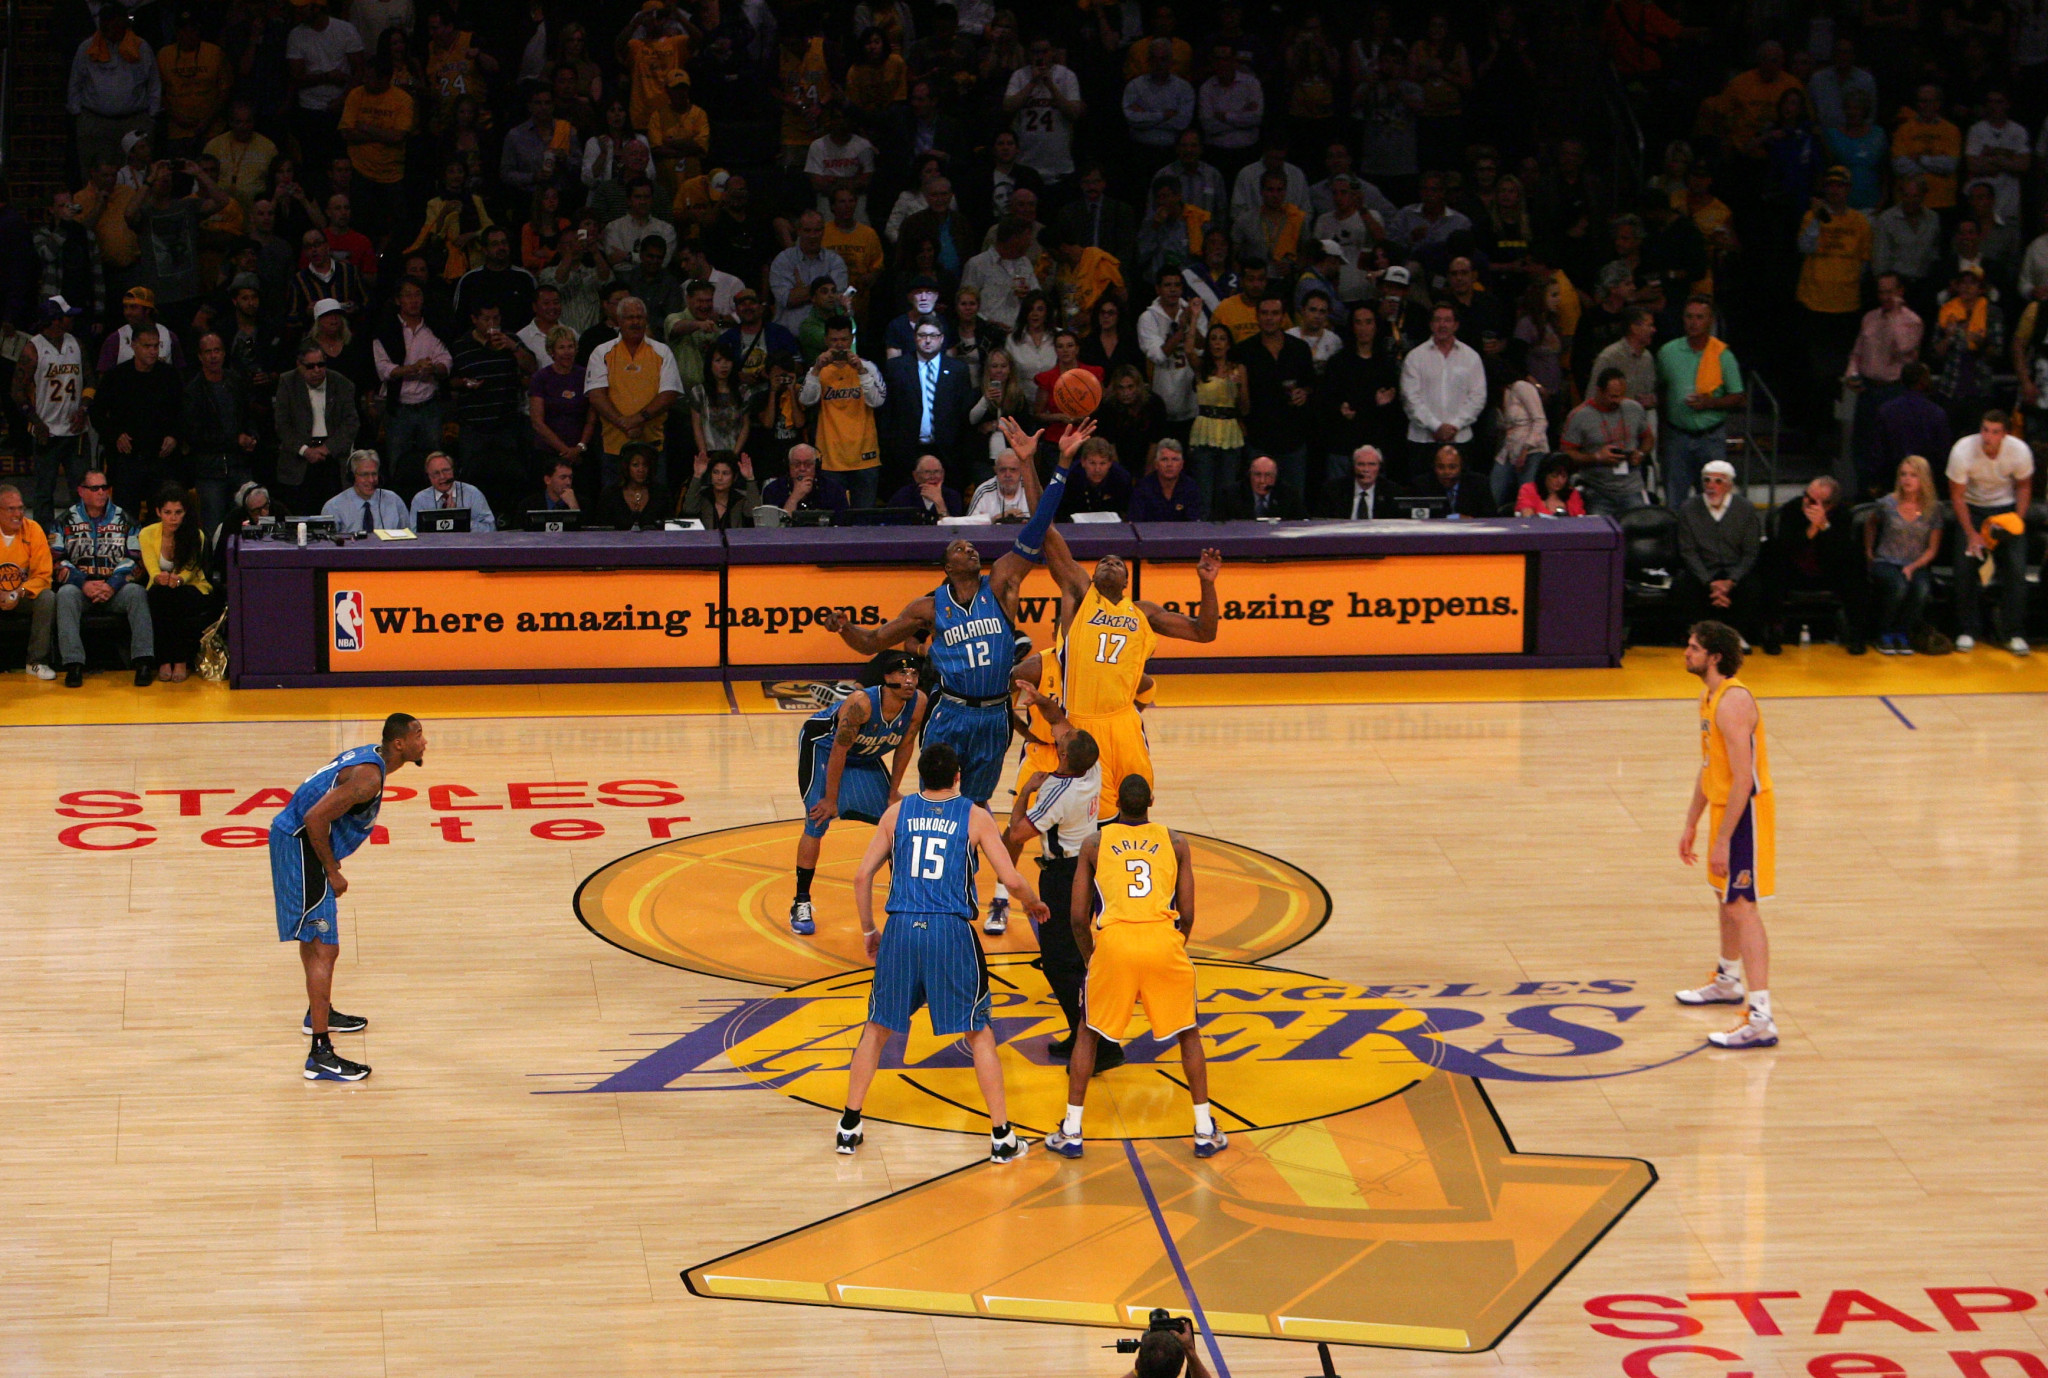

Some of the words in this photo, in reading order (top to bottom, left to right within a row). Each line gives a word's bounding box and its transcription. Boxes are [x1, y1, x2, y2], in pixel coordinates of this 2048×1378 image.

[1026, 109, 1054, 132] 24
[45, 362, 80, 378] LAKERS
[50, 378, 76, 401] 24
[824, 386, 861, 400] LAKERS
[370, 607, 505, 634] Where
[516, 603, 692, 638] amazing
[705, 602, 888, 634] happens.
[1348, 591, 1518, 624] happens.
[943, 618, 1002, 647] ORLANDO
[1087, 609, 1139, 632] LAKERS
[337, 638, 355, 648] NBA
[965, 641, 991, 669] 12
[1095, 632, 1127, 664] 17
[907, 818, 958, 835] TURKOGLU
[910, 835, 948, 880] 15
[1110, 839, 1160, 856] ARIZA
[1125, 859, 1153, 898] 3
[1197, 979, 1638, 1004] NGELES
[1583, 1286, 2048, 1340] STAP
